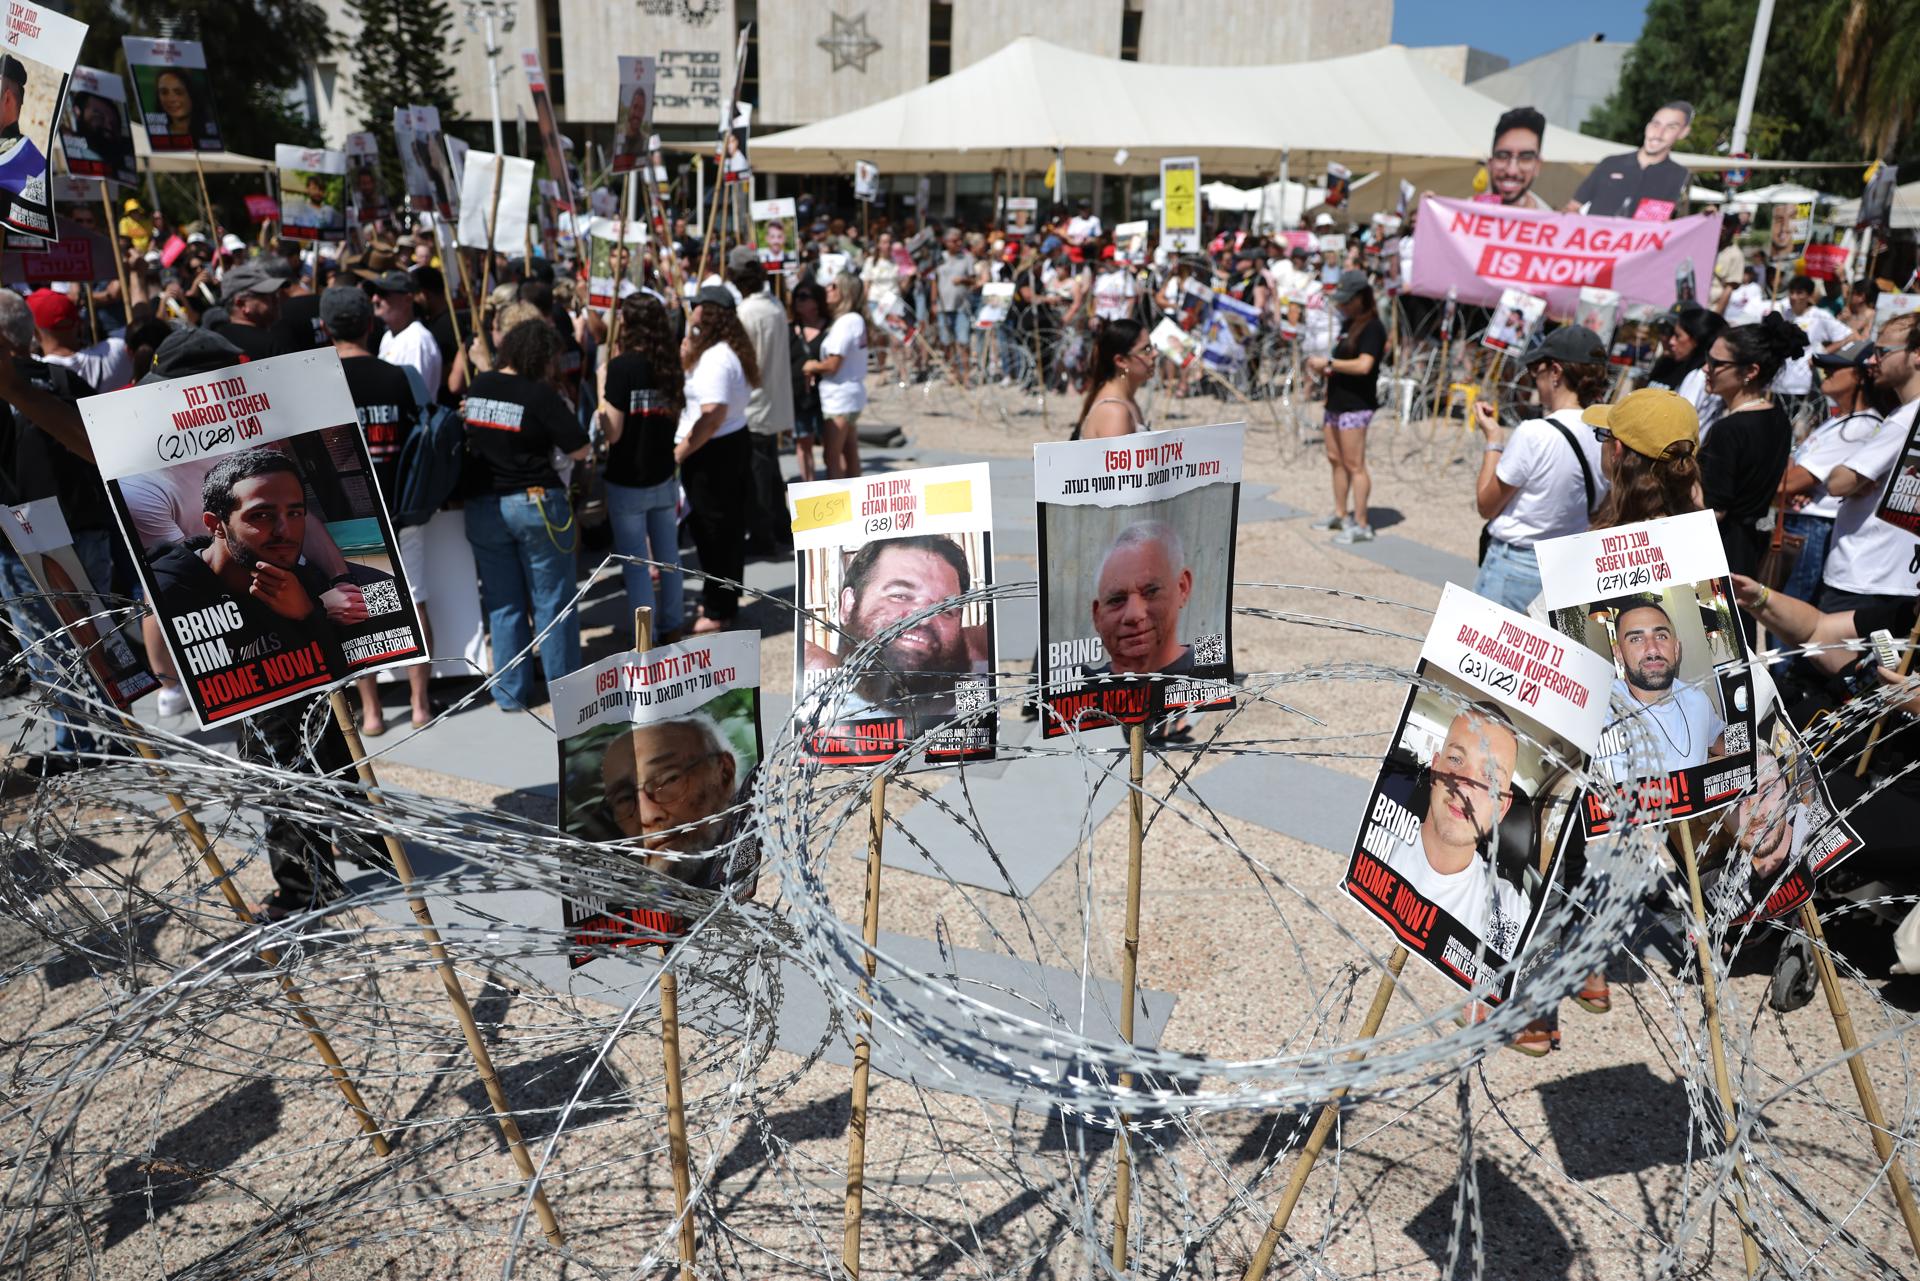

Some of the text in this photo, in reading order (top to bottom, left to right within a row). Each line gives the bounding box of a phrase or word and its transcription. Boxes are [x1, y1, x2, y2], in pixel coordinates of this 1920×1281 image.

[12, 18, 42, 39] ANGREST
[691, 82, 720, 93] בית
[1451, 212, 1671, 252] NEVER AGAIN
[1489, 251, 1606, 285] IS NOW
[183, 377, 247, 409] נמרוד כהן
[172, 392, 271, 431] NIMROD COHEN
[1105, 442, 1183, 472] אילן וייס (56)
[867, 479, 911, 500] איתן הורן
[1062, 461, 1219, 495] נרצח על ידי חמאס. עדיין חטוף בעזה.
[862, 495, 917, 517] EITAN HORN
[865, 516, 893, 535] (38)
[1601, 531, 1650, 556] שגב כלפון
[1595, 546, 1665, 573] SEGEV KALFON
[172, 601, 244, 646] BRING
[341, 625, 412, 652] HOSTAGES AND MISSING
[184, 637, 233, 676] HIM
[344, 635, 416, 664] FAMILIES FORUM
[1049, 637, 1102, 668] BRING
[1496, 620, 1565, 668] בר קופרשטיין
[197, 663, 264, 709] HOME
[262, 640, 328, 688] NOW!
[682, 648, 712, 675] אריה
[1457, 624, 1590, 709] BAR ABRAHAM KUPERSHTEIN
[596, 664, 619, 696] (85)
[1049, 666, 1083, 696] HIM
[1165, 681, 1191, 694] HOSTAGES
[577, 667, 736, 725] נרצח על ידי חמאס. עדיין חטוף בעזה.
[1049, 691, 1098, 725] HOME
[1164, 690, 1199, 705] FAMILIES
[855, 718, 905, 752] NOW!
[1703, 764, 1751, 787] HOSTAGES AND MISSING
[1704, 773, 1751, 800] FAMILIES FORUM
[1372, 793, 1421, 846] BRING
[1822, 825, 1842, 845] MISSING
[1362, 822, 1396, 864] HIM
[1824, 831, 1849, 855] FORUM
[1353, 853, 1440, 939] HOME NOW!
[1765, 873, 1807, 914] NOW!
[1442, 944, 1476, 980] FAMILIES
[1446, 934, 1473, 962] HOSTAGES
